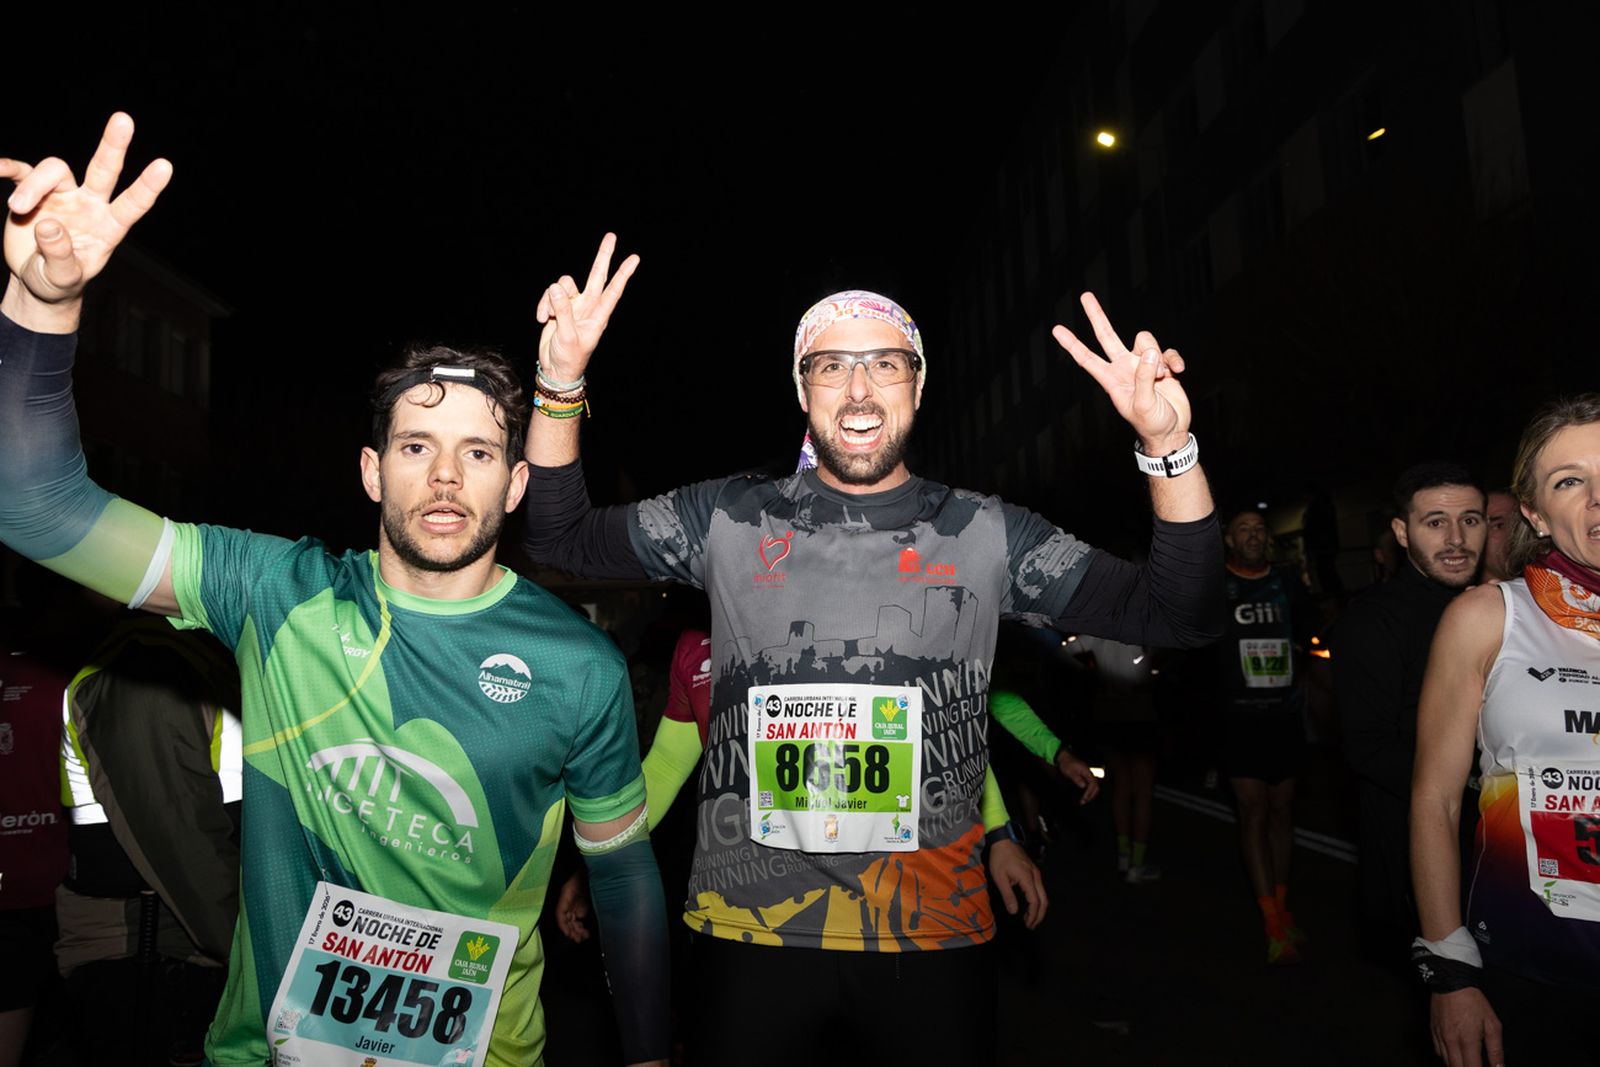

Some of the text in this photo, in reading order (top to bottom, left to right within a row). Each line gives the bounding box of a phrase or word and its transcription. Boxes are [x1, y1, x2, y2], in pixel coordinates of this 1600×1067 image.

[766, 699, 780, 712] 43
[783, 702, 834, 718] NOCHE
[766, 718, 857, 740] SAN ANTÓN
[775, 743, 890, 794] 8658
[1541, 771, 1562, 783] 43
[835, 797, 868, 810] Javier
[1545, 794, 1586, 812] SAN
[0, 810, 57, 829] erón
[361, 826, 472, 864] ingenieros
[333, 905, 353, 921] 43
[358, 907, 383, 920] CARRERA
[382, 913, 405, 924] URBANA
[311, 919, 323, 938] Enero
[352, 915, 443, 950] NOCHE DE
[321, 931, 434, 975] SAN ANTÓN
[454, 959, 489, 973] CAJA RURAL
[310, 959, 473, 1045] 13458
[355, 1035, 396, 1055] Javier
